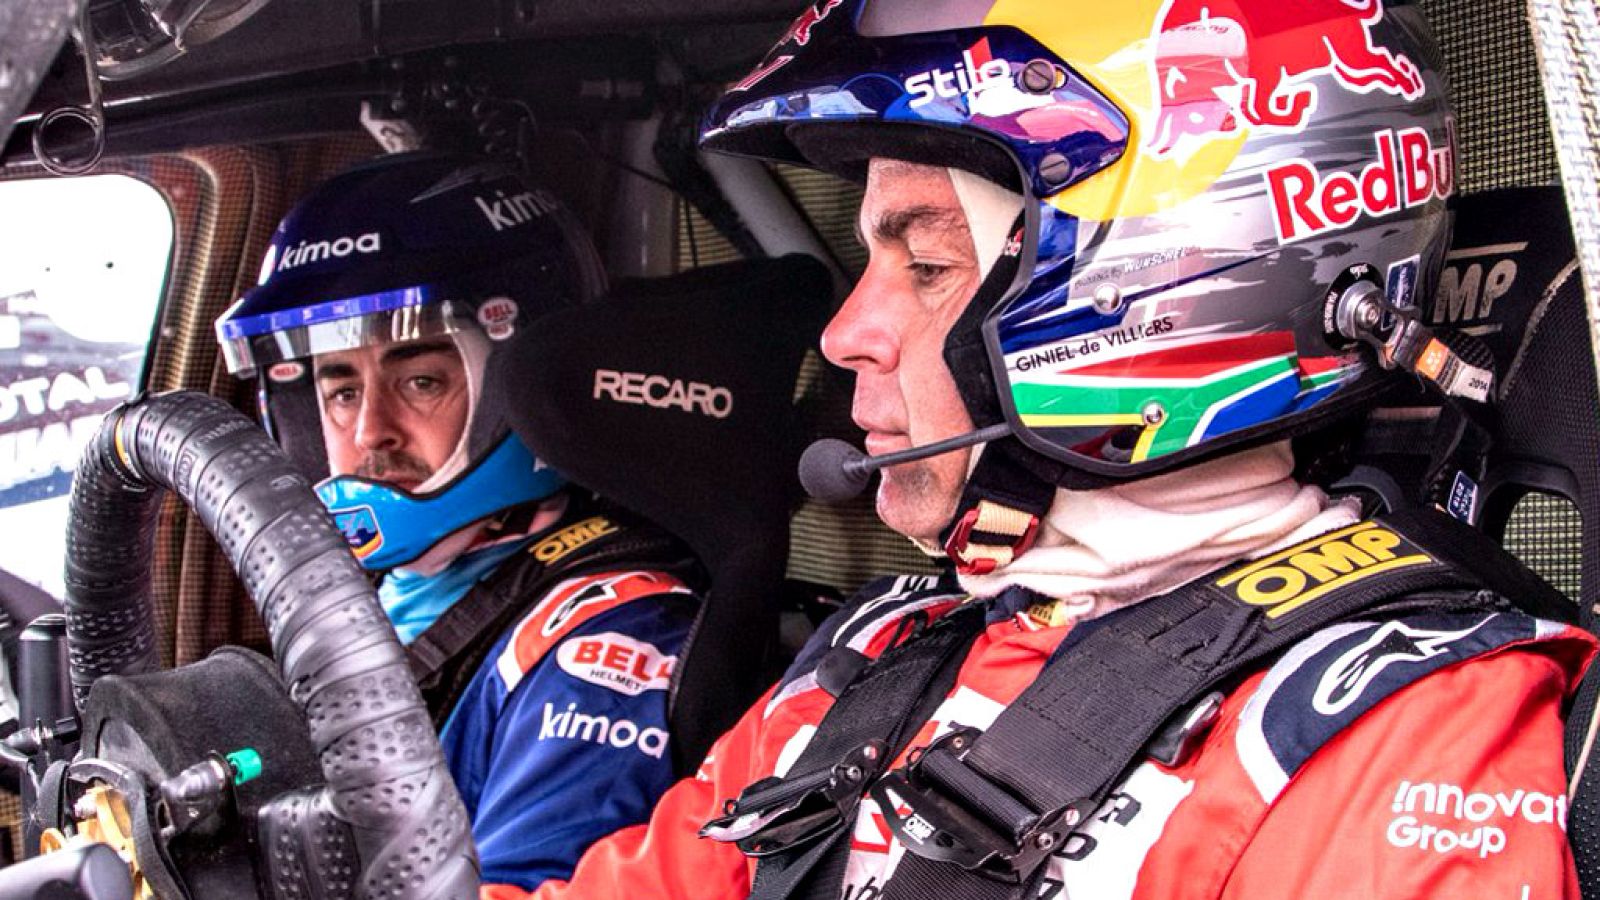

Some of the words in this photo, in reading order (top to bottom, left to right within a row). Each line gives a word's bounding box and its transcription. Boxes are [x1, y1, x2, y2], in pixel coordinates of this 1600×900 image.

[905, 49, 1011, 109] Stilo
[475, 190, 557, 231] kim
[1265, 130, 1400, 244] Red
[278, 232, 380, 272] kimoa
[1432, 258, 1518, 324] MP
[1016, 344, 1076, 372] GINIEL
[1079, 338, 1101, 356] de
[594, 369, 734, 419] RECARO
[1236, 526, 1401, 606] OMP
[538, 702, 669, 759] kimoa
[1386, 815, 1507, 859] Group
